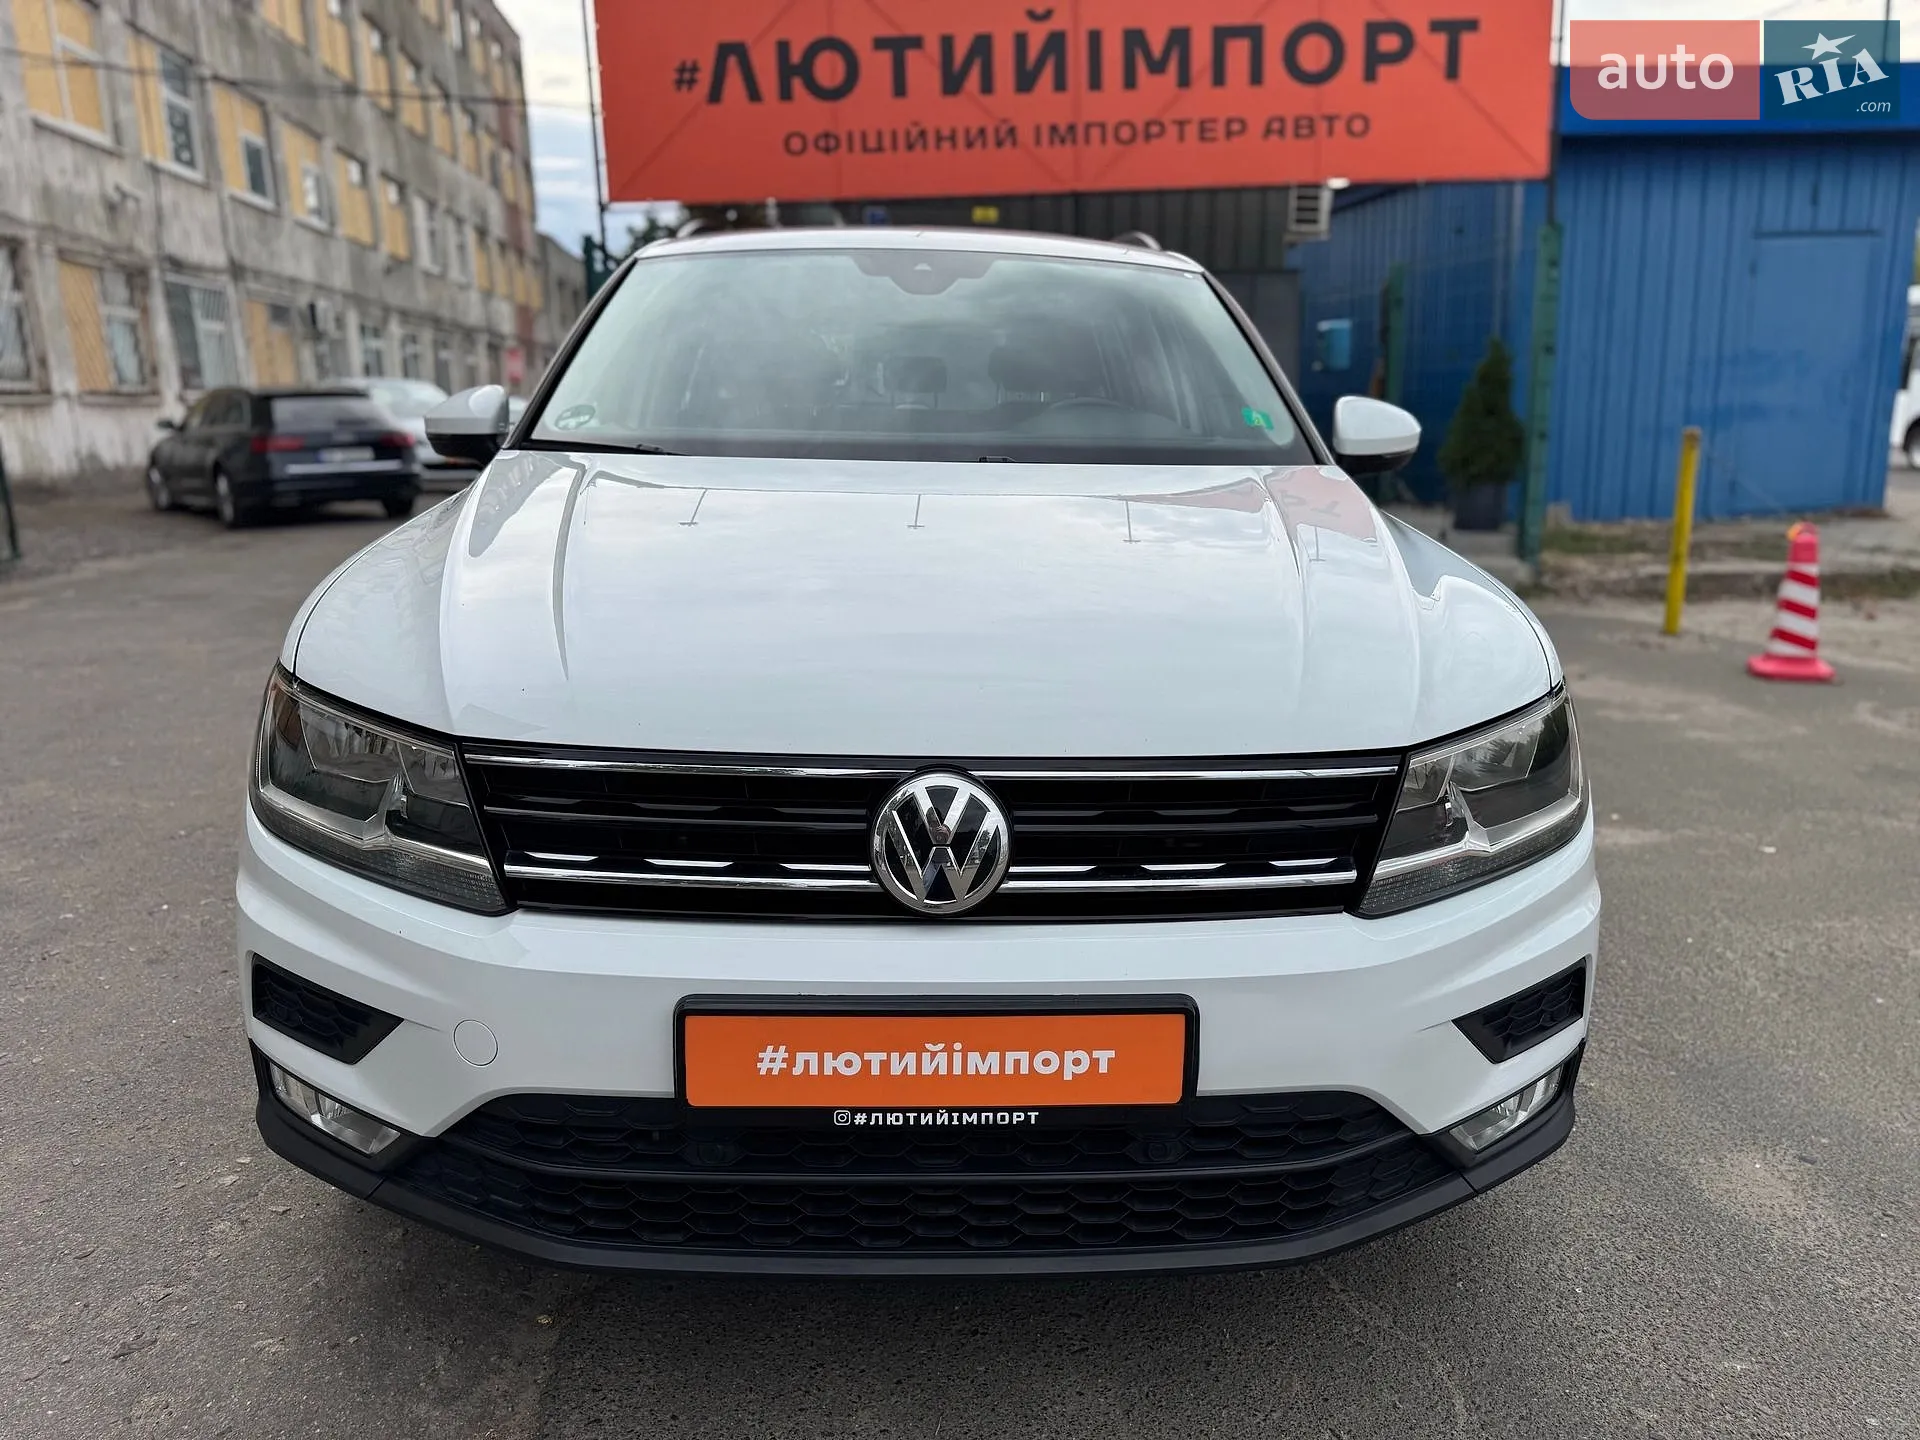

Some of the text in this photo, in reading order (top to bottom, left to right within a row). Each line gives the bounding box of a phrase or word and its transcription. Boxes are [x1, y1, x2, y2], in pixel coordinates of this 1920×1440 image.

[673, 8, 1480, 105] #ЛЮТИЙІМПОРТ
[783, 113, 1371, 157] ОФІЦІЙНИЙ ІМПОРТЕР АВТО
[756, 1042, 1116, 1081] #лютийімпорт
[853, 1109, 1039, 1126] #ЛЮТИЙІМПОРТ
